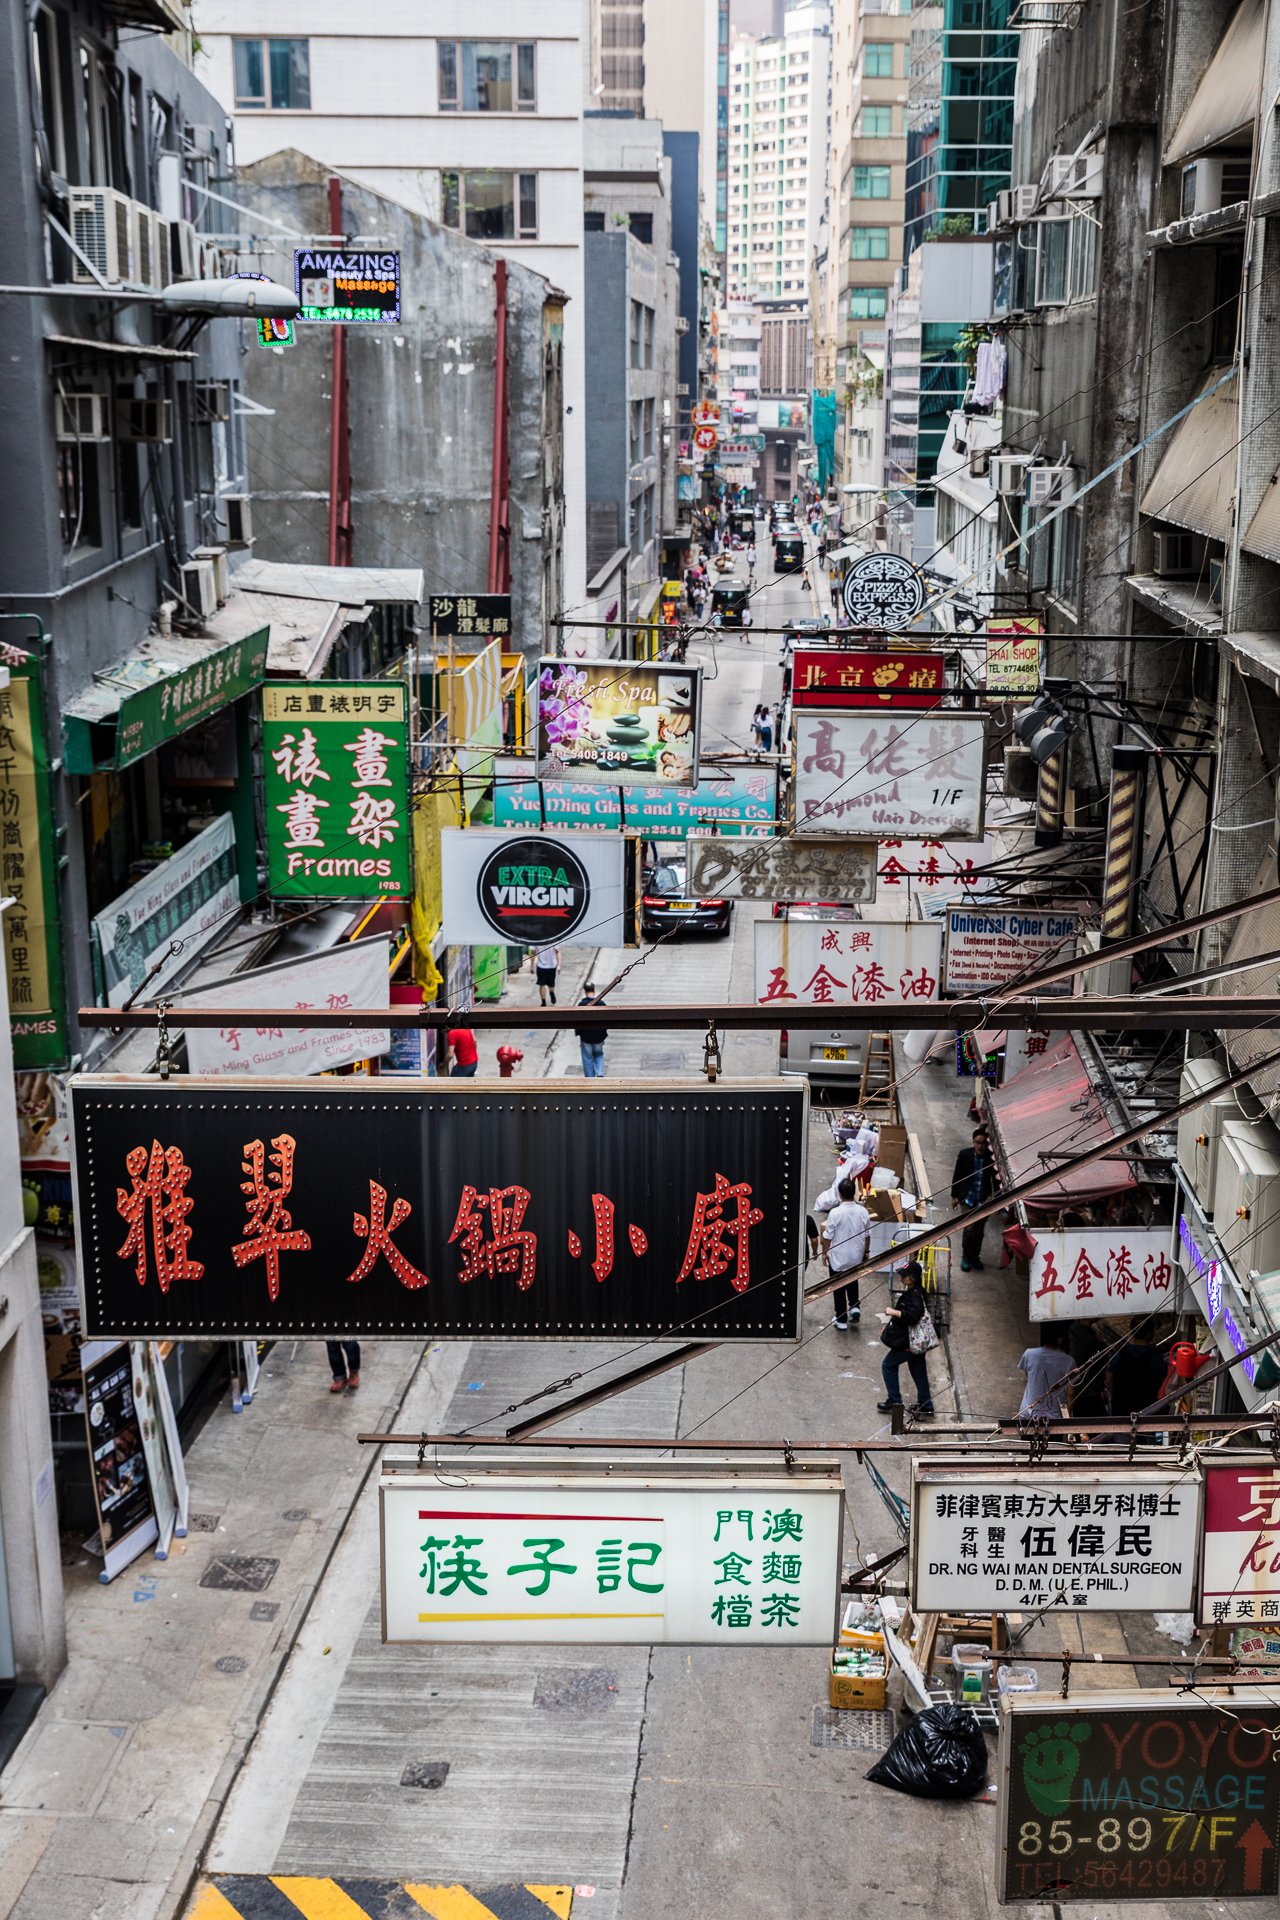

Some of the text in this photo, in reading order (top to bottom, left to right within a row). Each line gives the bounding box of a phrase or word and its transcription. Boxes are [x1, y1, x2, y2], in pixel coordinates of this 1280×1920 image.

[301, 254, 395, 270] AMAZING
[327, 269, 395, 281] Beauty & Spa
[335, 279, 395, 293] Massage
[864, 582, 903, 592] PIZZA
[853, 592, 914, 603] EXPRESS
[433, 598, 478, 617] 沙龍
[989, 648, 1037, 660] THAI SHOP
[989, 665, 1000, 673] TEL
[550, 678, 653, 709] Fresh Spa
[600, 751, 627, 761] 1849
[803, 781, 901, 819] Raymond
[932, 789, 963, 807] 1/F
[509, 797, 772, 820] Yue Ming Glass and Frames Co.
[872, 810, 904, 826] Hair
[651, 825, 682, 835] 2541
[286, 852, 392, 878] Frames
[498, 866, 570, 886] EXTRA
[378, 881, 401, 890] 1983
[490, 886, 575, 906] VIRGIN
[951, 914, 1073, 937] Universal Cyber Café
[964, 936, 995, 946] (Internet
[997, 937, 1020, 948] Shop)
[952, 960, 960, 968] Fax
[975, 950, 993, 959] Printing
[997, 950, 1010, 958] Photo
[1012, 951, 1023, 960] Copy
[222, 1061, 249, 1074] Ming
[252, 1049, 284, 1064] Glass
[287, 1041, 308, 1055] and
[311, 1031, 352, 1051] Frames
[324, 1032, 386, 1058] Since 1983
[935, 1494, 1181, 1519] 菲律賓東方大學牙科博士
[1020, 1524, 1153, 1558] 伍偉民
[419, 1535, 665, 1597] 筷子記
[929, 1562, 1182, 1575] DR. NG WAI MAN DENTAL SURGEON
[1020, 1594, 1049, 1606] 4/F
[1102, 1719, 1273, 1770] YOYO
[1083, 1776, 1266, 1811] MASSAGE
[1017, 1817, 1237, 1856] 85-89 7/F
